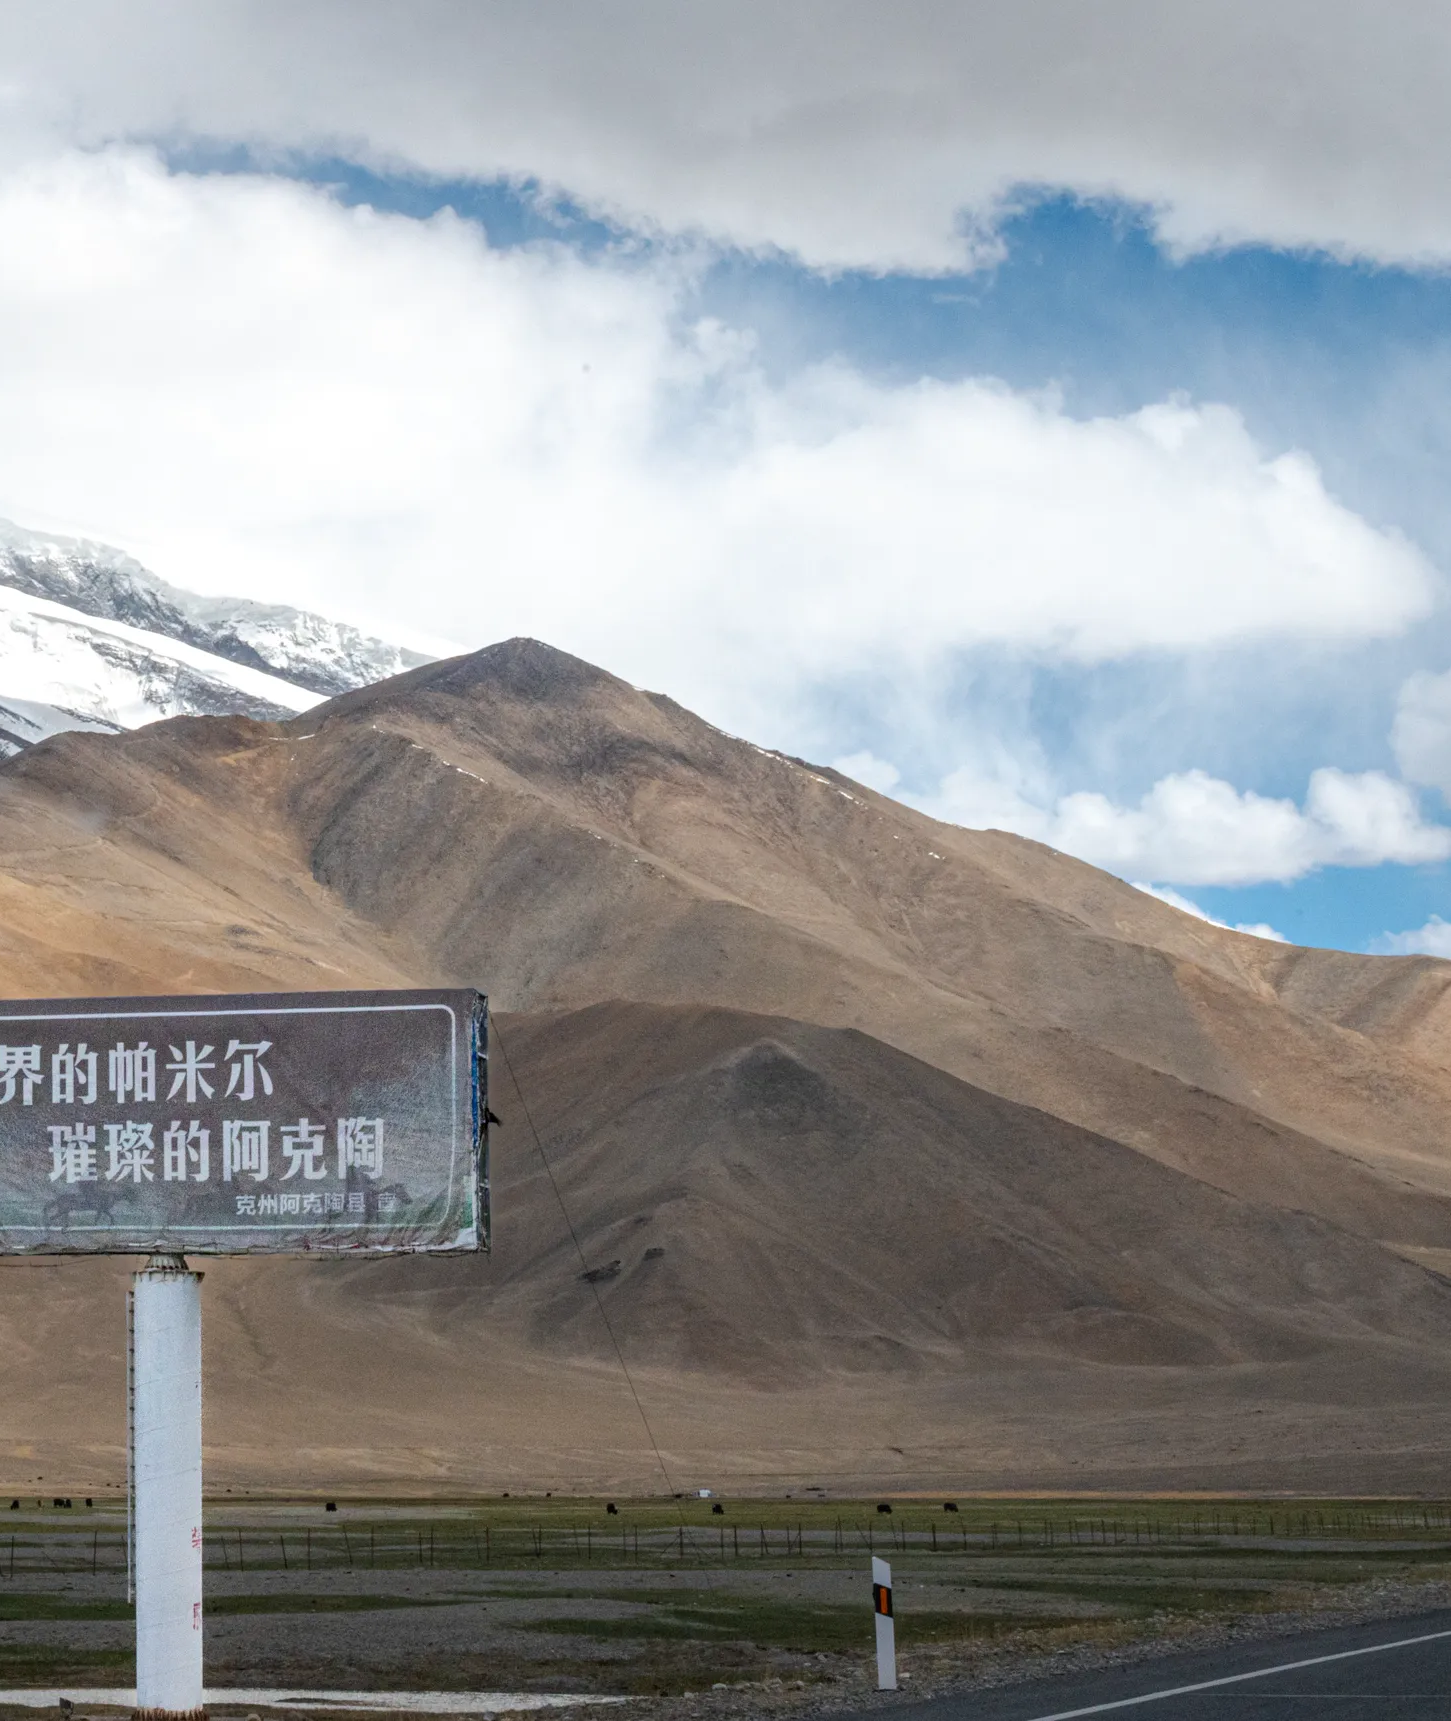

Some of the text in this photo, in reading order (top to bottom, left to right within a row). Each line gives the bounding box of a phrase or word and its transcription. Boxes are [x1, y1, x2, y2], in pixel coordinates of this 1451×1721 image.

[47, 1117, 385, 1183] 璀璨的阿克陶
